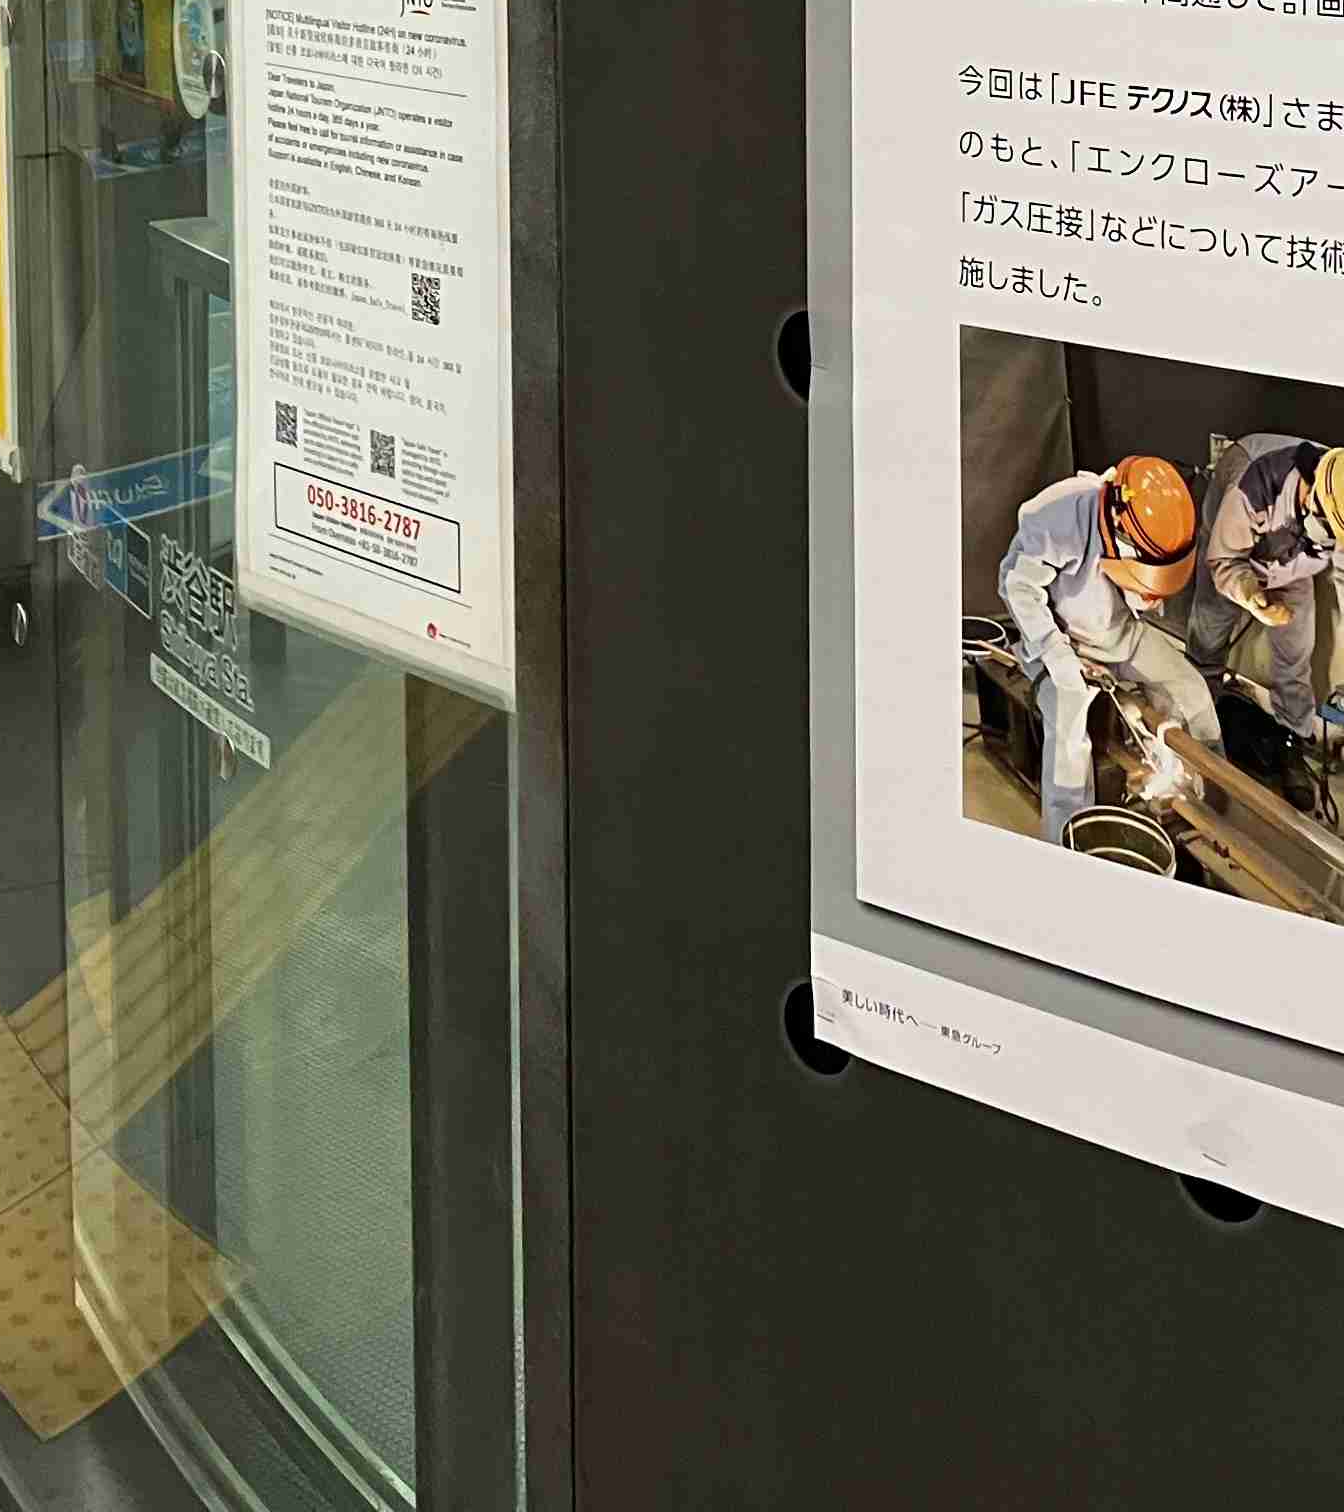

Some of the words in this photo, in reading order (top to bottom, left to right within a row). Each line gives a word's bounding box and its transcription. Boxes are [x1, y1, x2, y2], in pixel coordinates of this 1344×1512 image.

[959, 256, 1104, 308] 施しました。
[306, 484, 421, 541] 050-3816-2787
[842, 988, 920, 1028] 美しい時代へ
